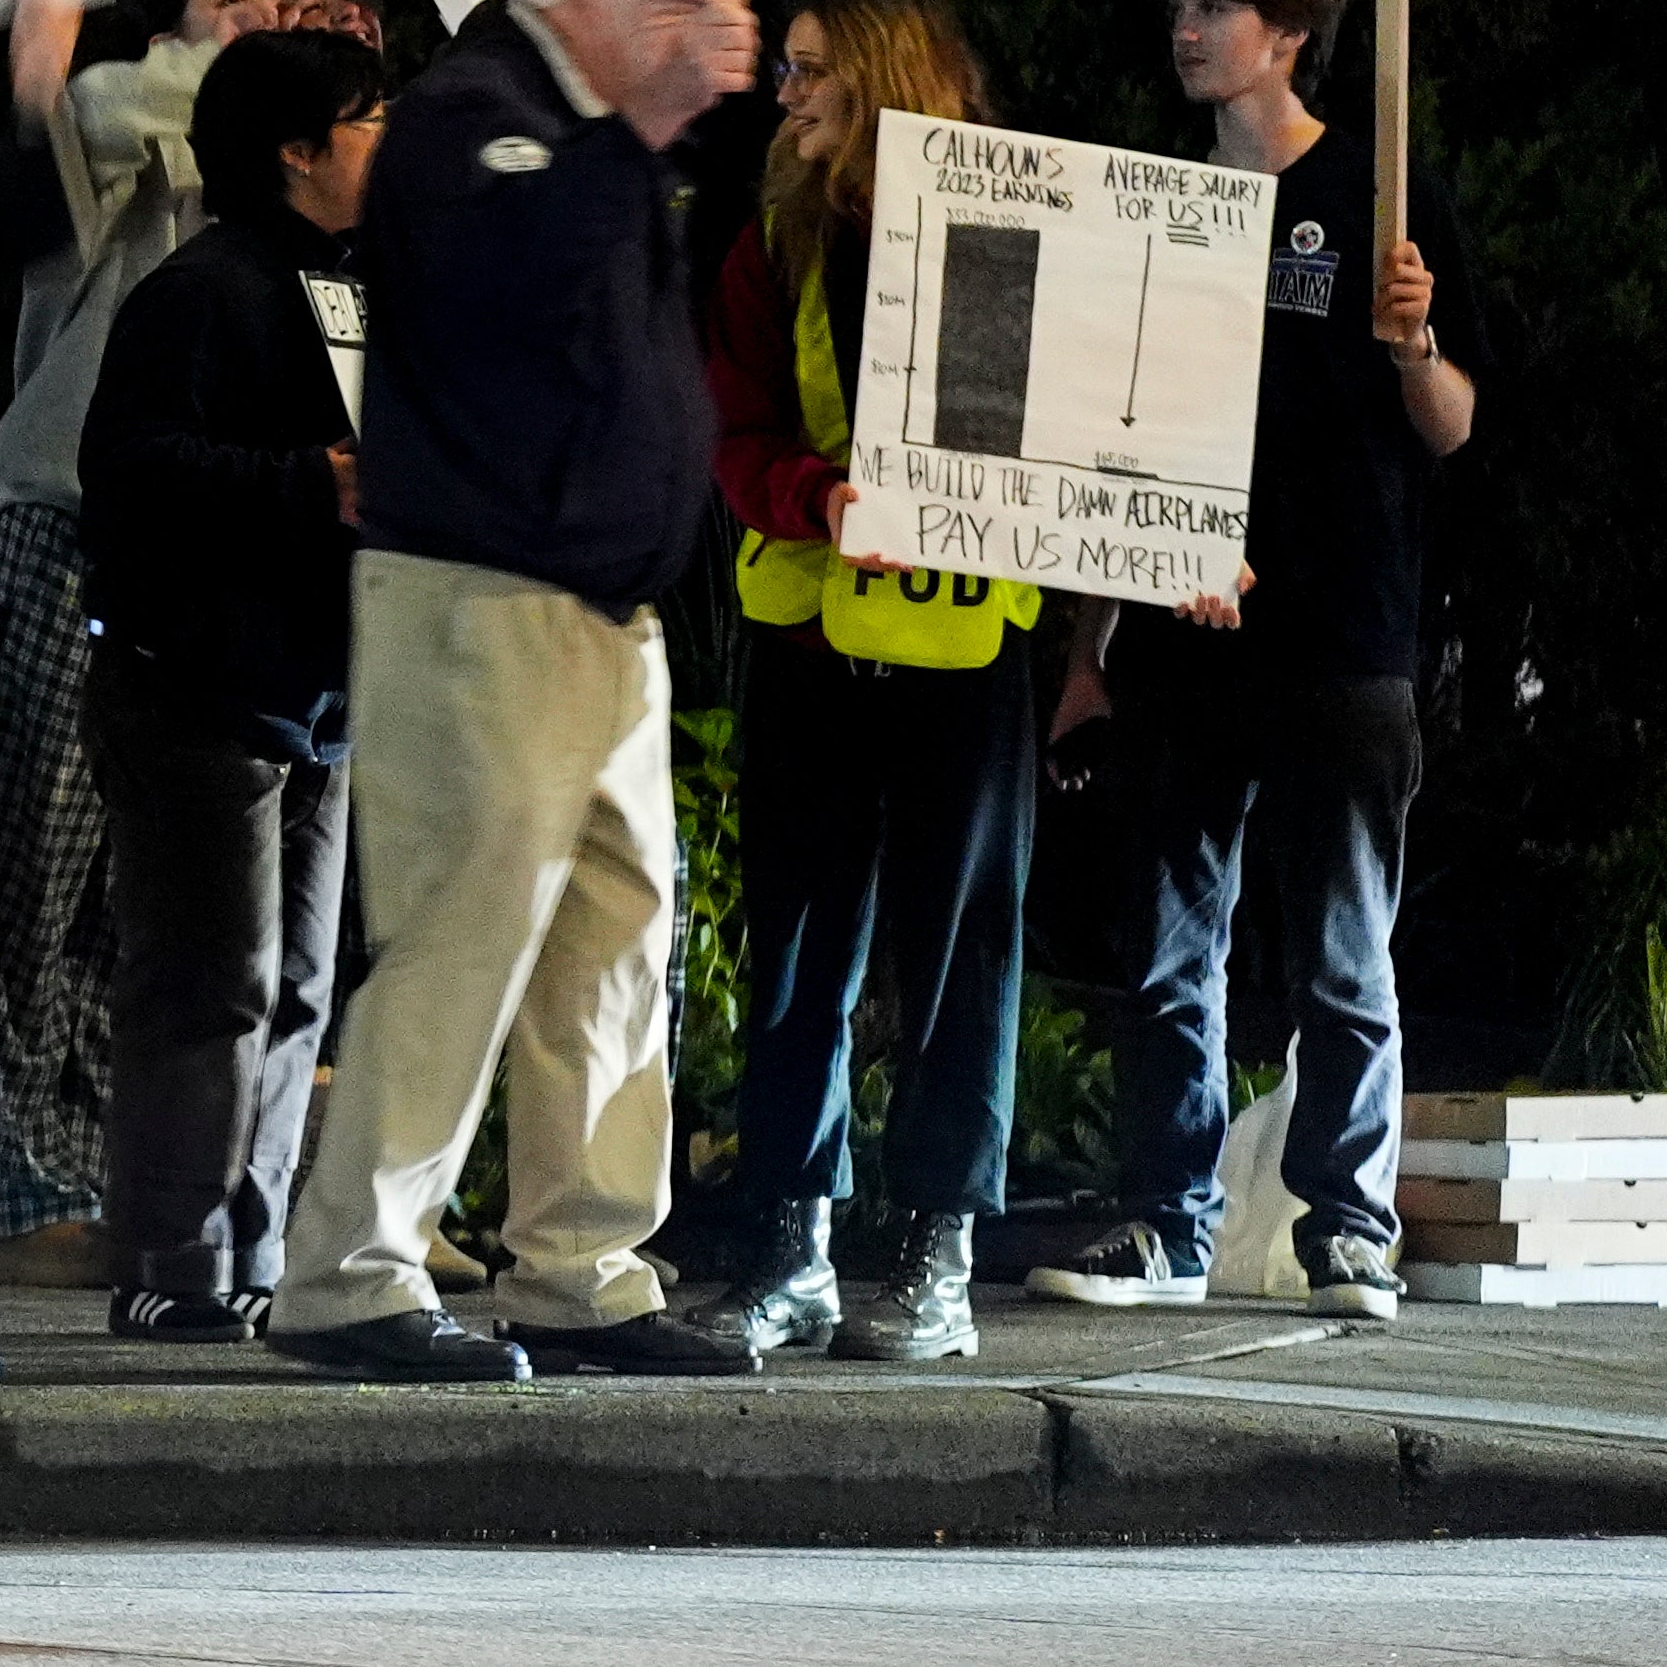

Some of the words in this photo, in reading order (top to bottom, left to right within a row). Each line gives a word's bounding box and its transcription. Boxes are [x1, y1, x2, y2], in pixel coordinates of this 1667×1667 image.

[936, 169, 986, 199] 2023
[990, 178, 1074, 212] EARNINGS
[1103, 153, 1191, 196] AVERAGE
[1199, 171, 1262, 207] SALARY
[1115, 193, 1157, 221] FOR
[855, 442, 894, 487] WE
[907, 449, 985, 501] BUILD
[997, 467, 1044, 508] THE
[1058, 476, 1117, 520] DAMN
[1124, 489, 1249, 539] AIRPLANES
[916, 504, 994, 562] PAY
[1013, 525, 1062, 571] US
